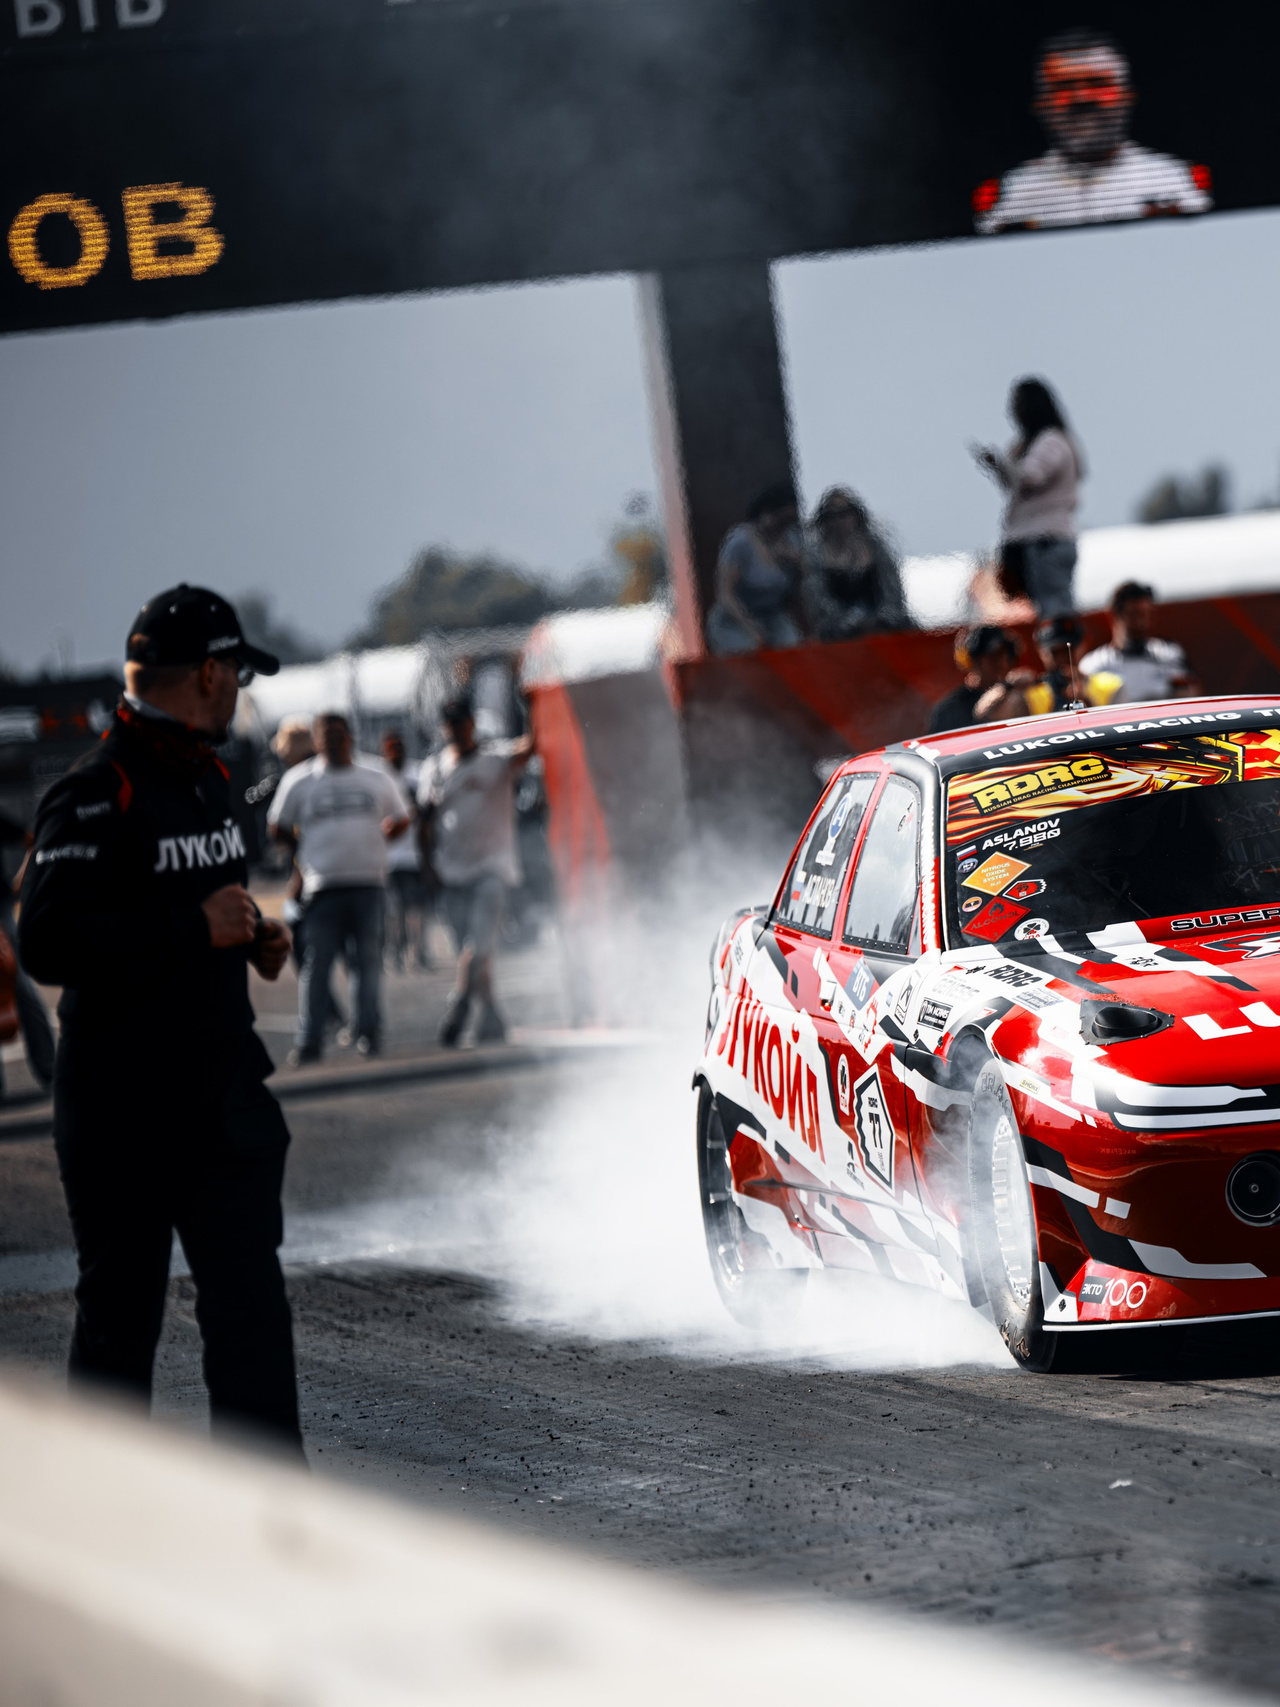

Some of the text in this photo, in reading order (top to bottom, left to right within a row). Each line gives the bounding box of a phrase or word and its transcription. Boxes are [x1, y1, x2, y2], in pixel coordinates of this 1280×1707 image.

[983, 729, 1105, 760] LUKOIL
[1112, 711, 1242, 734] RACING
[972, 757, 1105, 809] RDRC
[983, 773, 1109, 813] RUSSIAN DRAG RACING CHAMPIONSHIP
[982, 818, 1060, 850] ASLANOV
[981, 862, 1010, 874] NITROUS
[982, 872, 1009, 883] SYSTEM
[986, 868, 1006, 877] OXIDE
[970, 910, 1021, 931] ALCOHOL
[983, 964, 1043, 988] RDRC
[716, 990, 826, 1166] ЛУКОЙЛ
[868, 1112, 883, 1149] 77
[1082, 1278, 1147, 1309] ЭКТО 100
